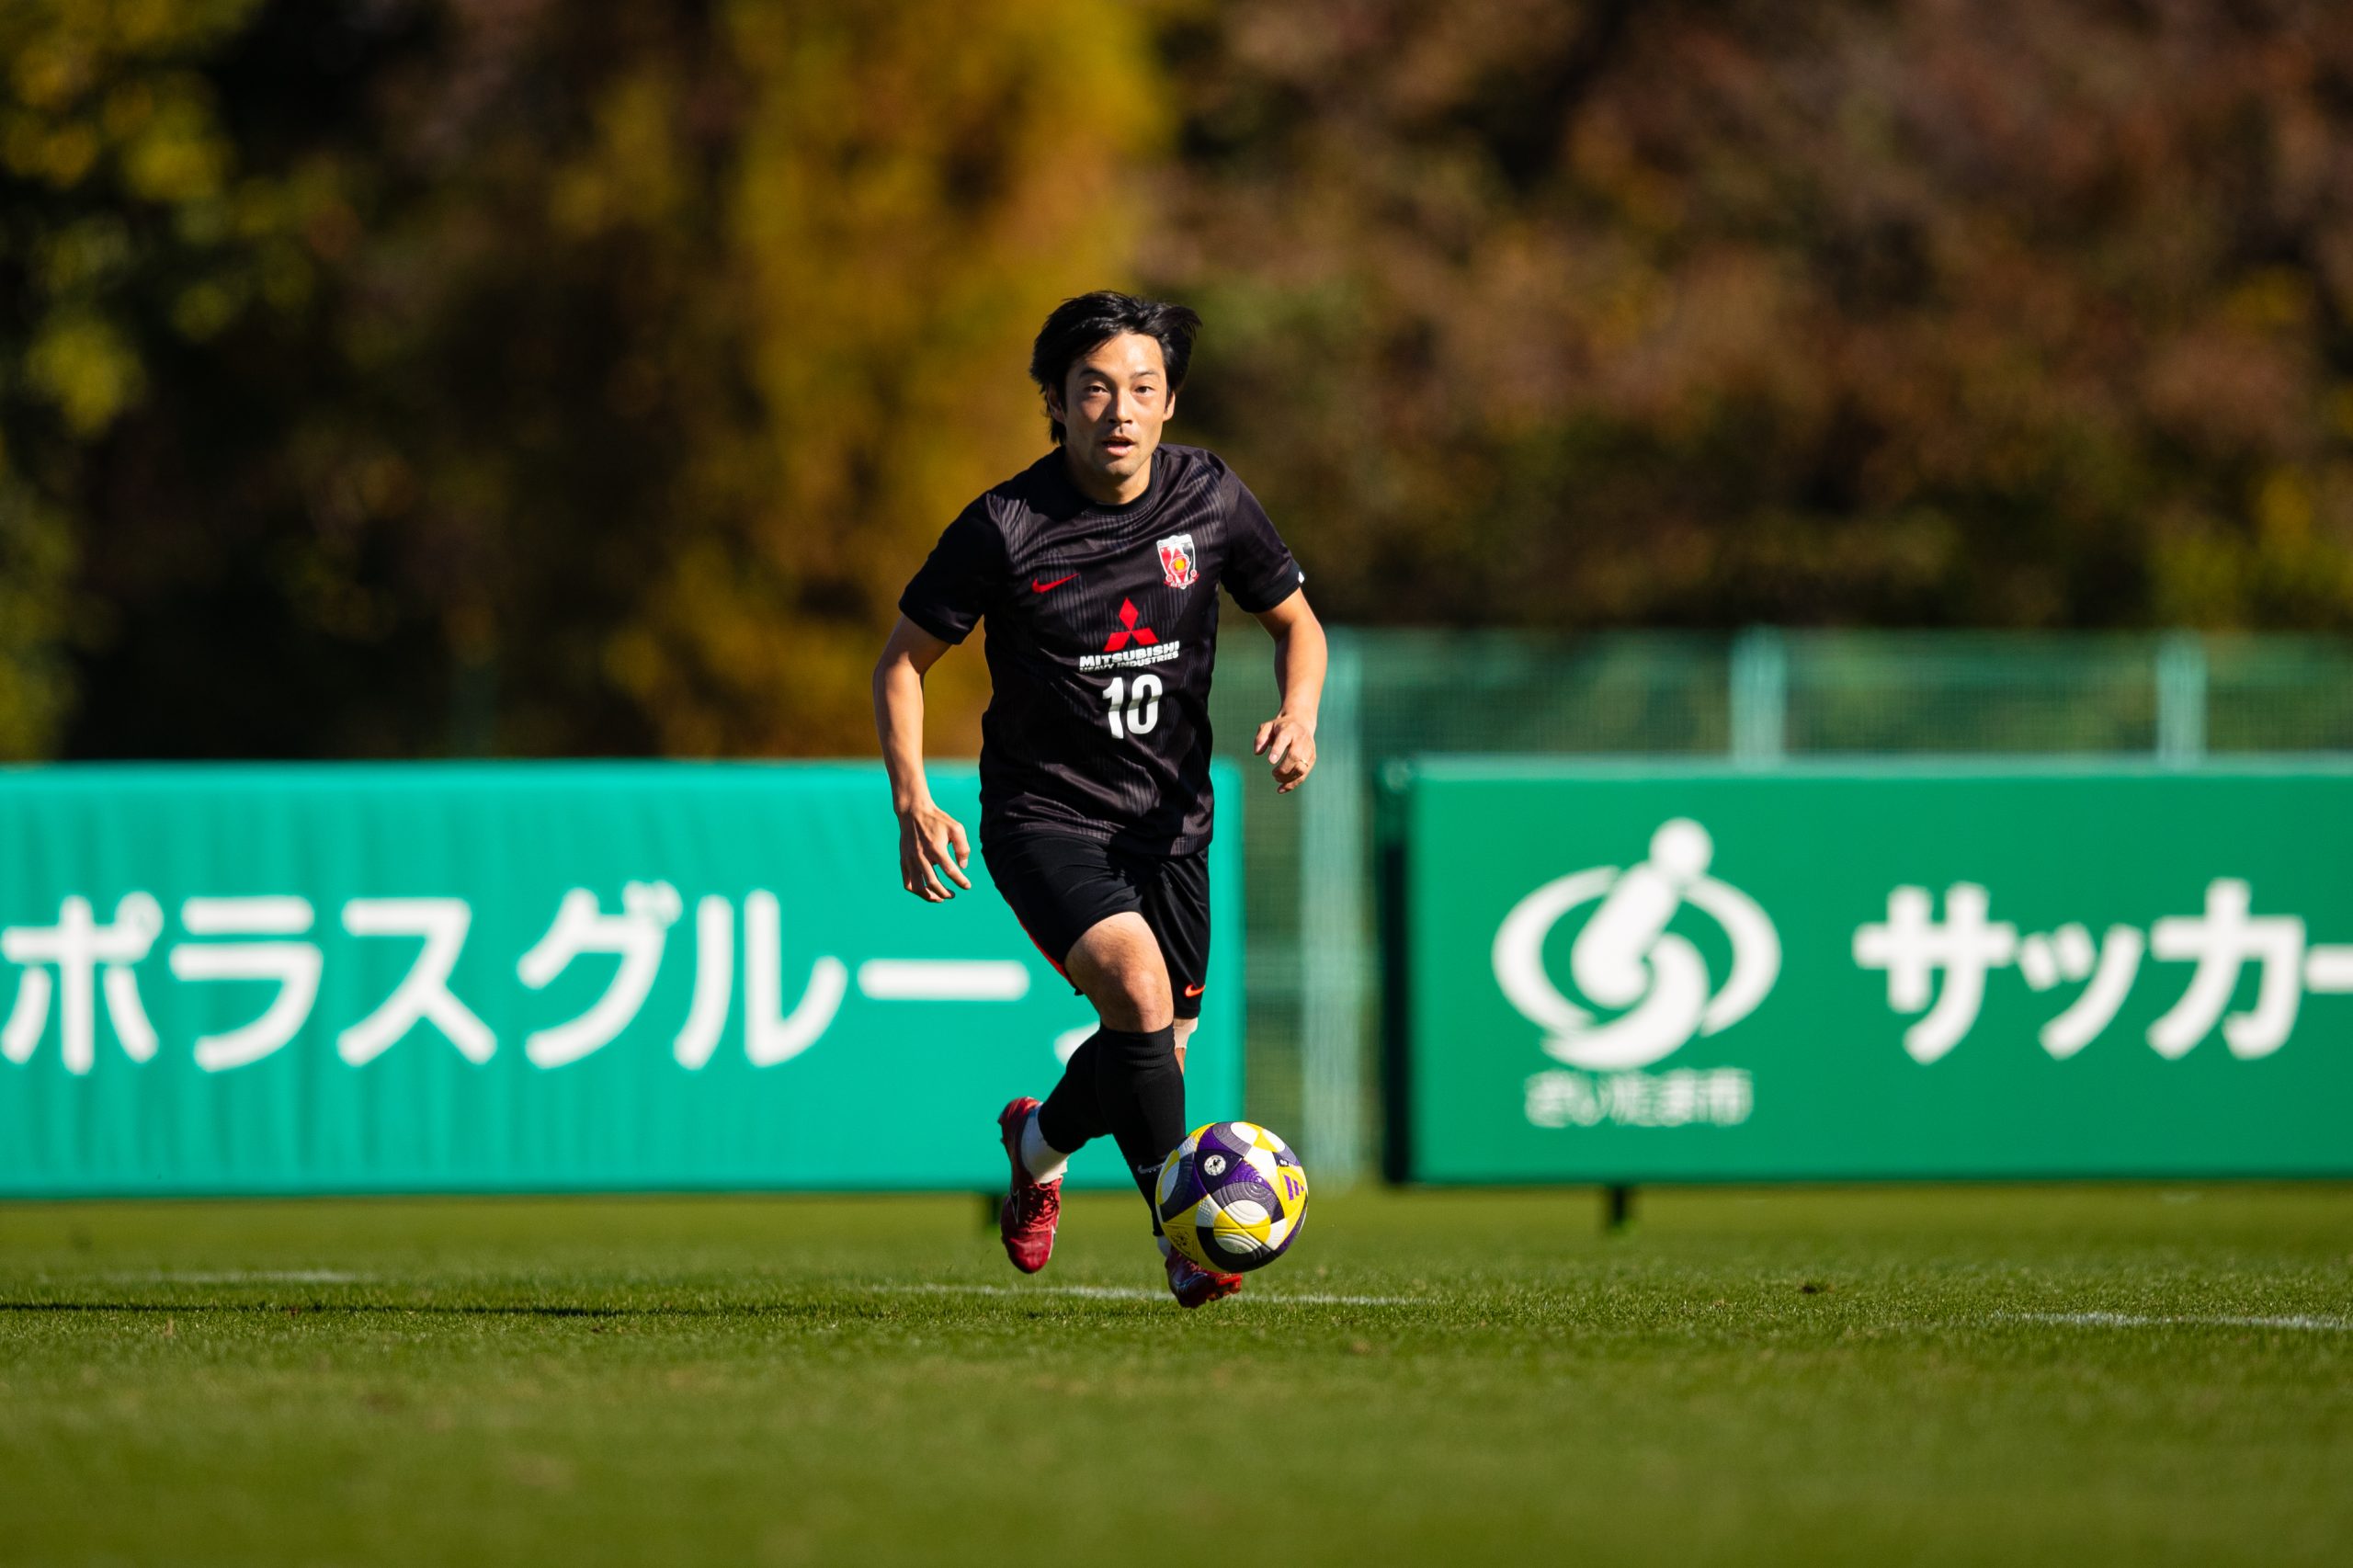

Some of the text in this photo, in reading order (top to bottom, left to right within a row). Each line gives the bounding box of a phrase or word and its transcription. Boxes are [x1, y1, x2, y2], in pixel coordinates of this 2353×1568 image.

[1079, 641, 1180, 667] MITSUBISHI
[1117, 651, 1179, 668] INDUSTRIES
[1102, 674, 1163, 739] 10
[0, 879, 1101, 1076] ポラスグルー
